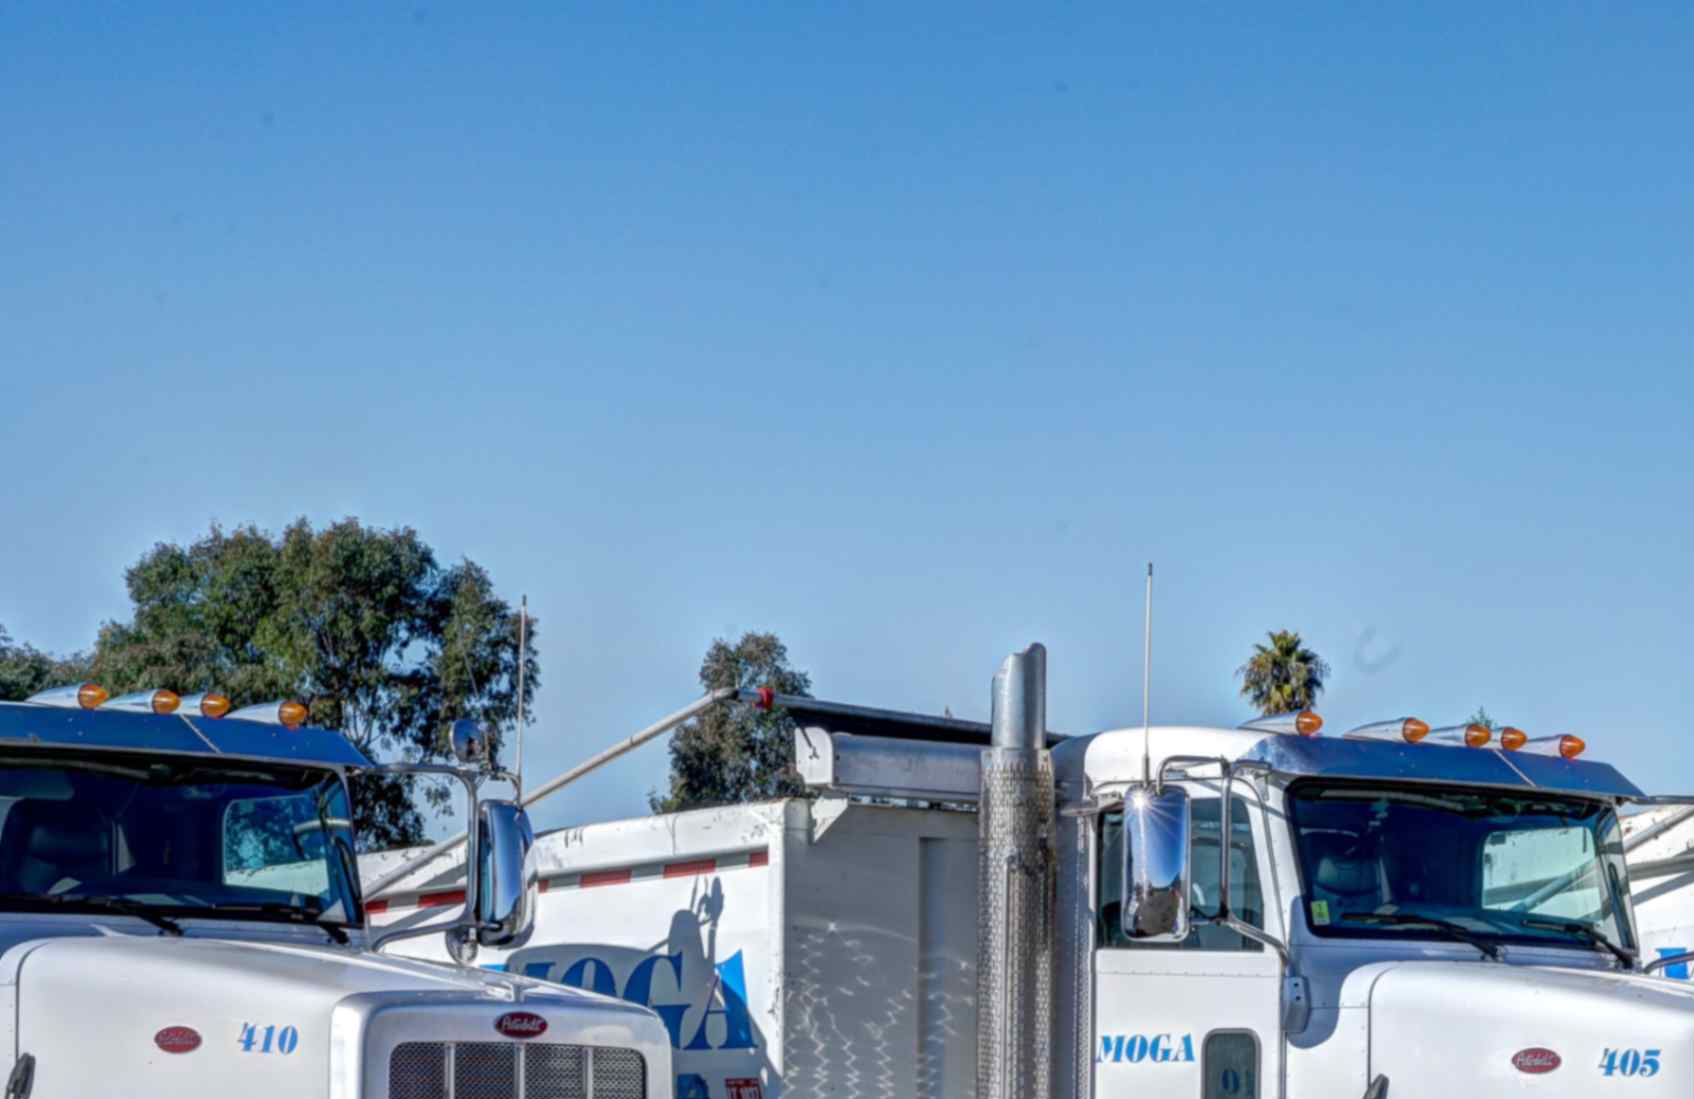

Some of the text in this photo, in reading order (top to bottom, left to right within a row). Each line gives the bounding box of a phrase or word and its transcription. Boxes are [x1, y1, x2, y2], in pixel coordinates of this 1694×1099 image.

[479, 948, 758, 1050] OGA
[237, 1022, 298, 1055] 410
[1095, 1032, 1195, 1063] MOGA
[1598, 1047, 1663, 1077] 405
